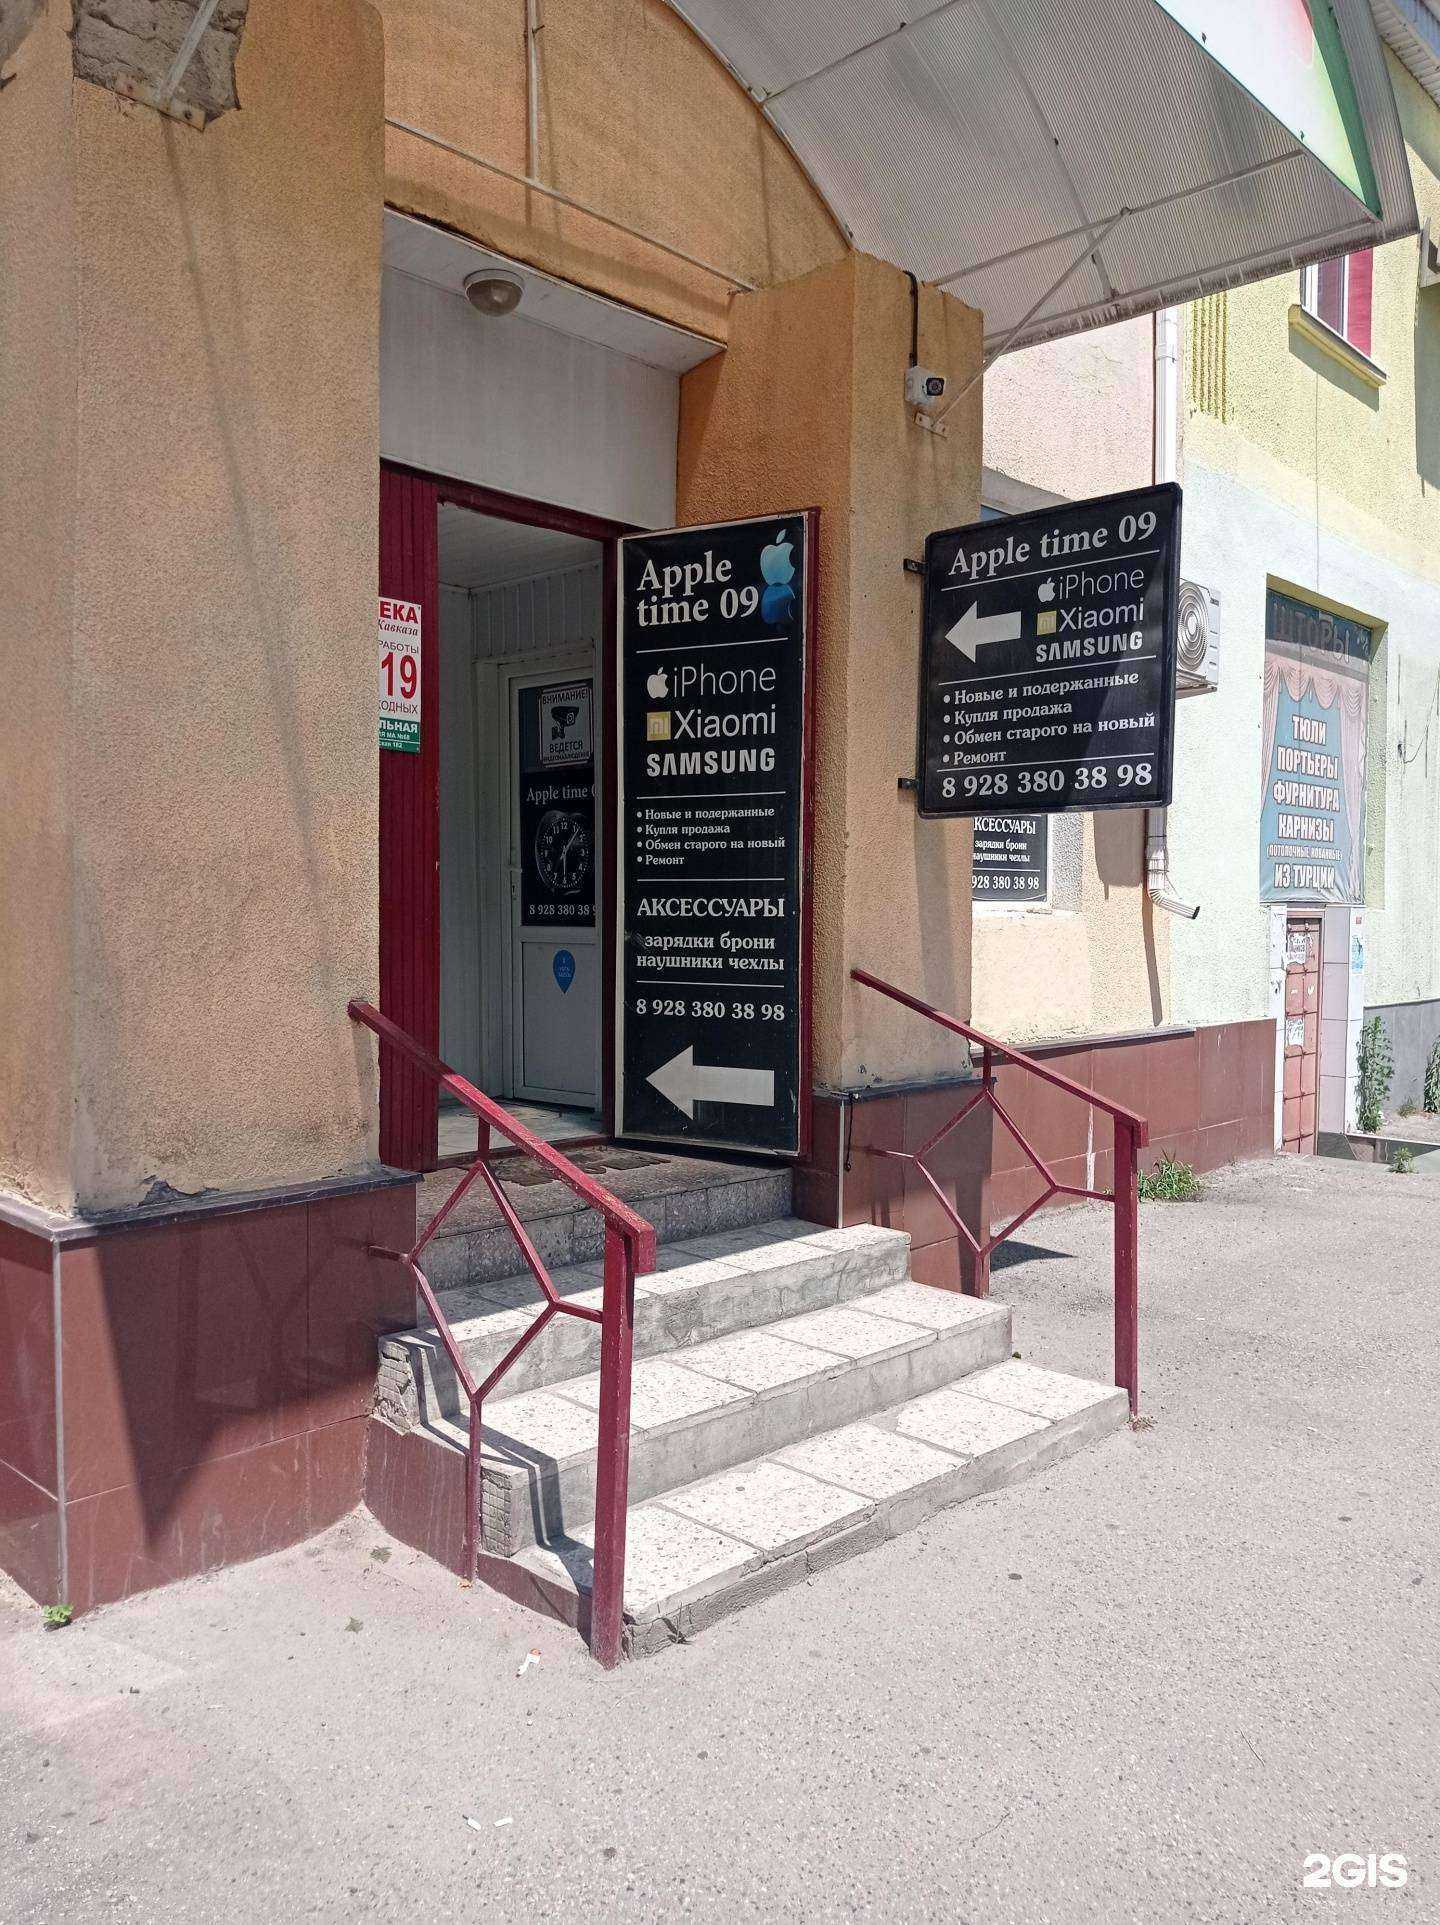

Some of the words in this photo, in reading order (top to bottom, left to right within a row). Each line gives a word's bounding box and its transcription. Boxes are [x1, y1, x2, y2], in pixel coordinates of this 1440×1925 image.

[949, 536, 1030, 580] Apple
[1040, 527, 1108, 559] time
[1119, 511, 1157, 543] 09
[637, 550, 732, 598] Apple
[1060, 569, 1144, 599] iPhone
[637, 595, 709, 627] time
[720, 586, 759, 619] 09
[1059, 597, 1144, 632] Xiaomi
[1036, 631, 1143, 663] SAMSUNG
[381, 651, 417, 699] 19
[674, 663, 776, 697] iPhone
[954, 688, 1004, 705] Новые
[1008, 687, 1018, 699] и
[1022, 673, 1139, 699] подержанные
[674, 704, 776, 740] Xiaomi
[954, 711, 998, 726] Купля
[1003, 702, 1072, 722] продажа
[954, 730, 1002, 745] Обмен
[1006, 724, 1067, 742] старого
[1072, 721, 1092, 734] на
[1098, 712, 1155, 731] новый
[1292, 715, 1326, 746] ТЮЛИ
[646, 748, 775, 777] SAMSUNG
[953, 751, 1006, 766] Ремонт
[1277, 745, 1338, 780] ПОРТЬЕРЫ
[527, 785, 559, 805] Apple
[562, 785, 588, 799] time
[941, 777, 956, 798] 8
[964, 774, 1008, 797] 928
[1017, 770, 1065, 793] 380
[1074, 766, 1107, 789] 38
[1117, 763, 1152, 787] 98
[1273, 780, 1340, 812] ФУРНИТУРА
[645, 809, 682, 820] Новые
[685, 810, 692, 819] и
[695, 807, 775, 820] подержанные
[973, 816, 1036, 834] КСЕССУАРЫ
[1278, 813, 1334, 842] КАРНИЗЫ
[645, 824, 678, 836] Купля
[682, 824, 730, 836] продажа
[645, 839, 681, 850] Обмен
[684, 839, 727, 851] старого
[731, 839, 744, 849] на
[748, 837, 785, 848] новый
[974, 840, 1004, 850] зарядки
[1005, 838, 1027, 851] брони
[645, 855, 685, 865] Ремонт
[1009, 854, 1030, 862] чехлы
[971, 875, 990, 889] 928
[992, 876, 1011, 889] 380
[1013, 876, 1025, 889] 38
[1028, 877, 1040, 889] 98
[1274, 863, 1291, 888] ИЗ
[1292, 864, 1335, 892] ТУРЦИИ
[529, 905, 535, 915] 8
[538, 905, 555, 915] 928
[557, 905, 575, 915] 380
[578, 905, 590, 915] 38
[637, 898, 785, 917] АКСЕССУАРЫ
[645, 935, 714, 951] зарядки
[719, 932, 775, 952] брони
[637, 955, 723, 970] наушники
[729, 956, 784, 971] чехлы
[636, 999, 647, 1014] 8
[652, 1000, 686, 1016] 928
[692, 1002, 725, 1018] 380
[732, 1003, 755, 1020] 38
[761, 1004, 785, 1021] 98
